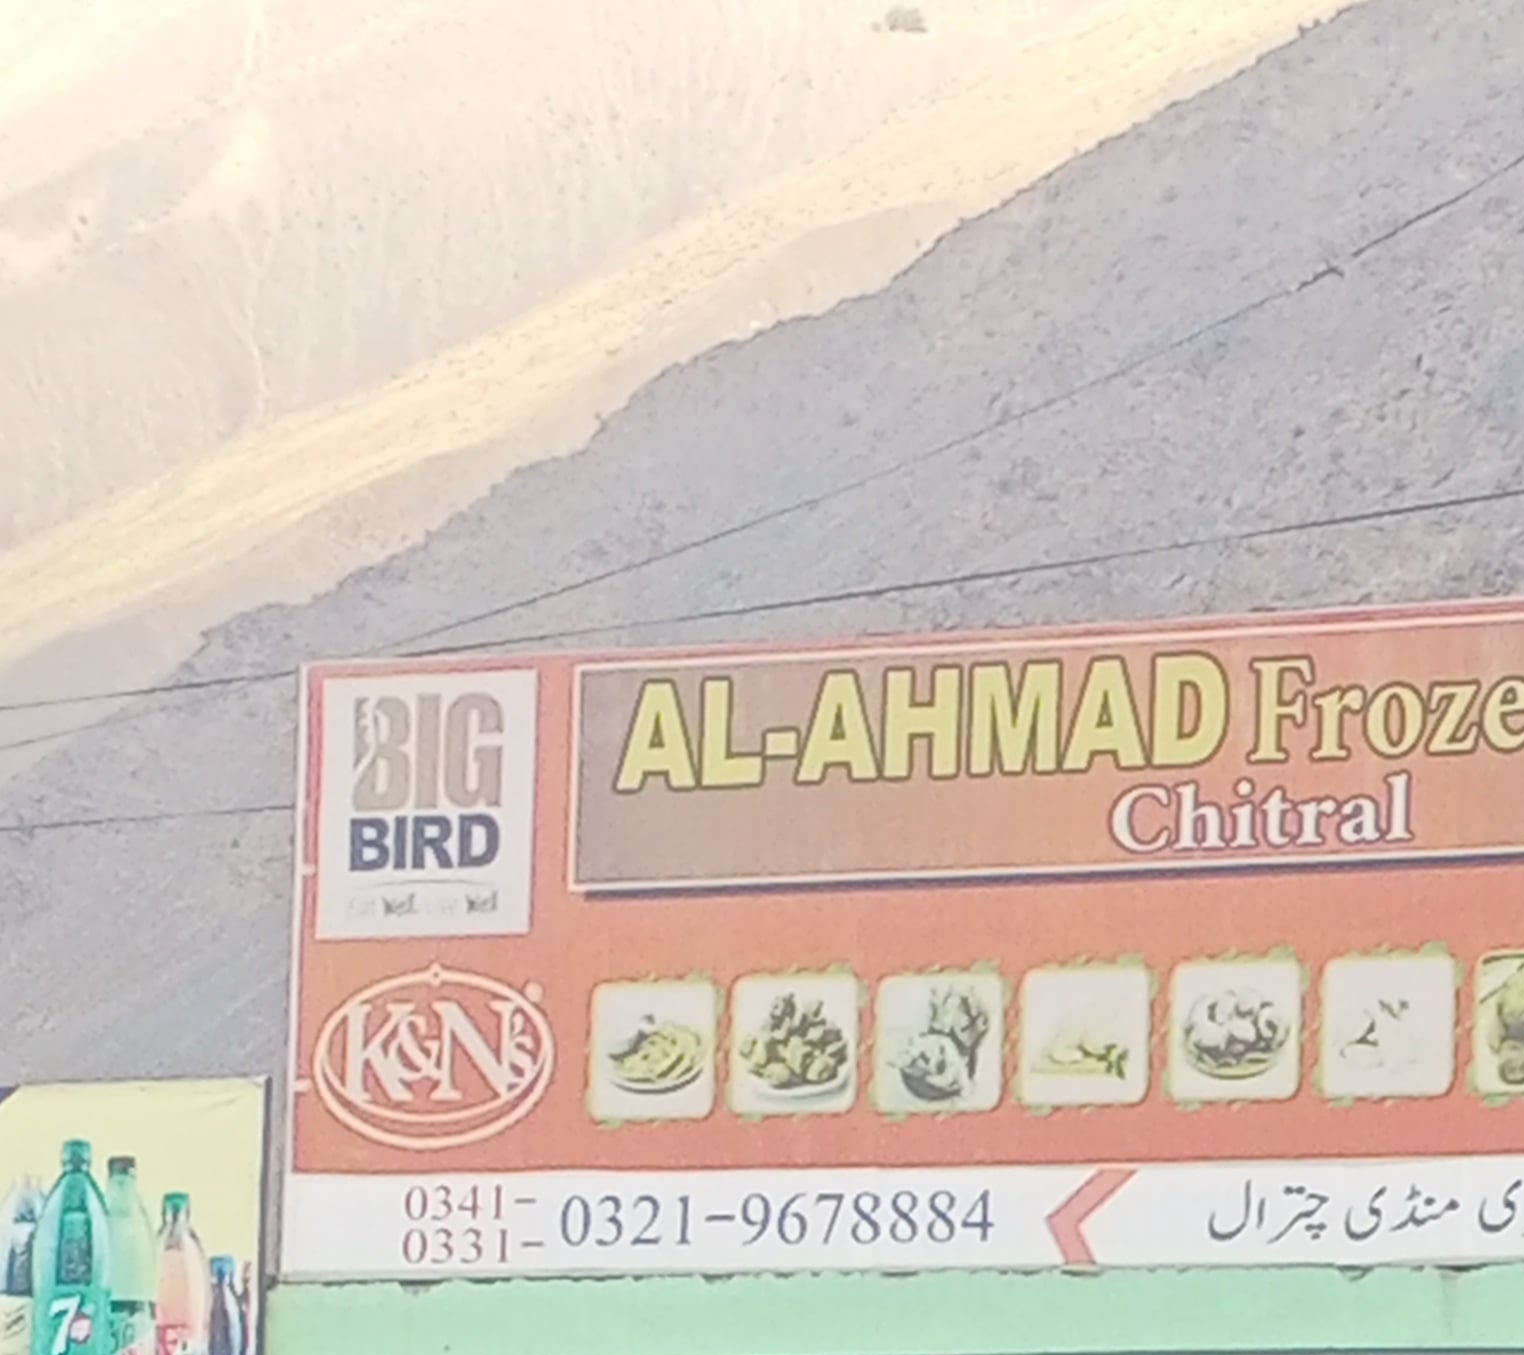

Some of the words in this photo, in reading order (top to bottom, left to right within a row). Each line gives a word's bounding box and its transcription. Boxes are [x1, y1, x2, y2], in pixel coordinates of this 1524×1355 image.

[351, 691, 504, 812] BIG
[612, 654, 1229, 796] AL-AHMAD
[348, 812, 500, 873] BIRD
[1108, 769, 1414, 852] Chitral
[560, 1188, 995, 1247] 0321-9678884
[1207, 1178, 1331, 1245] چترال
[1343, 1183, 1461, 1242] منڈی
